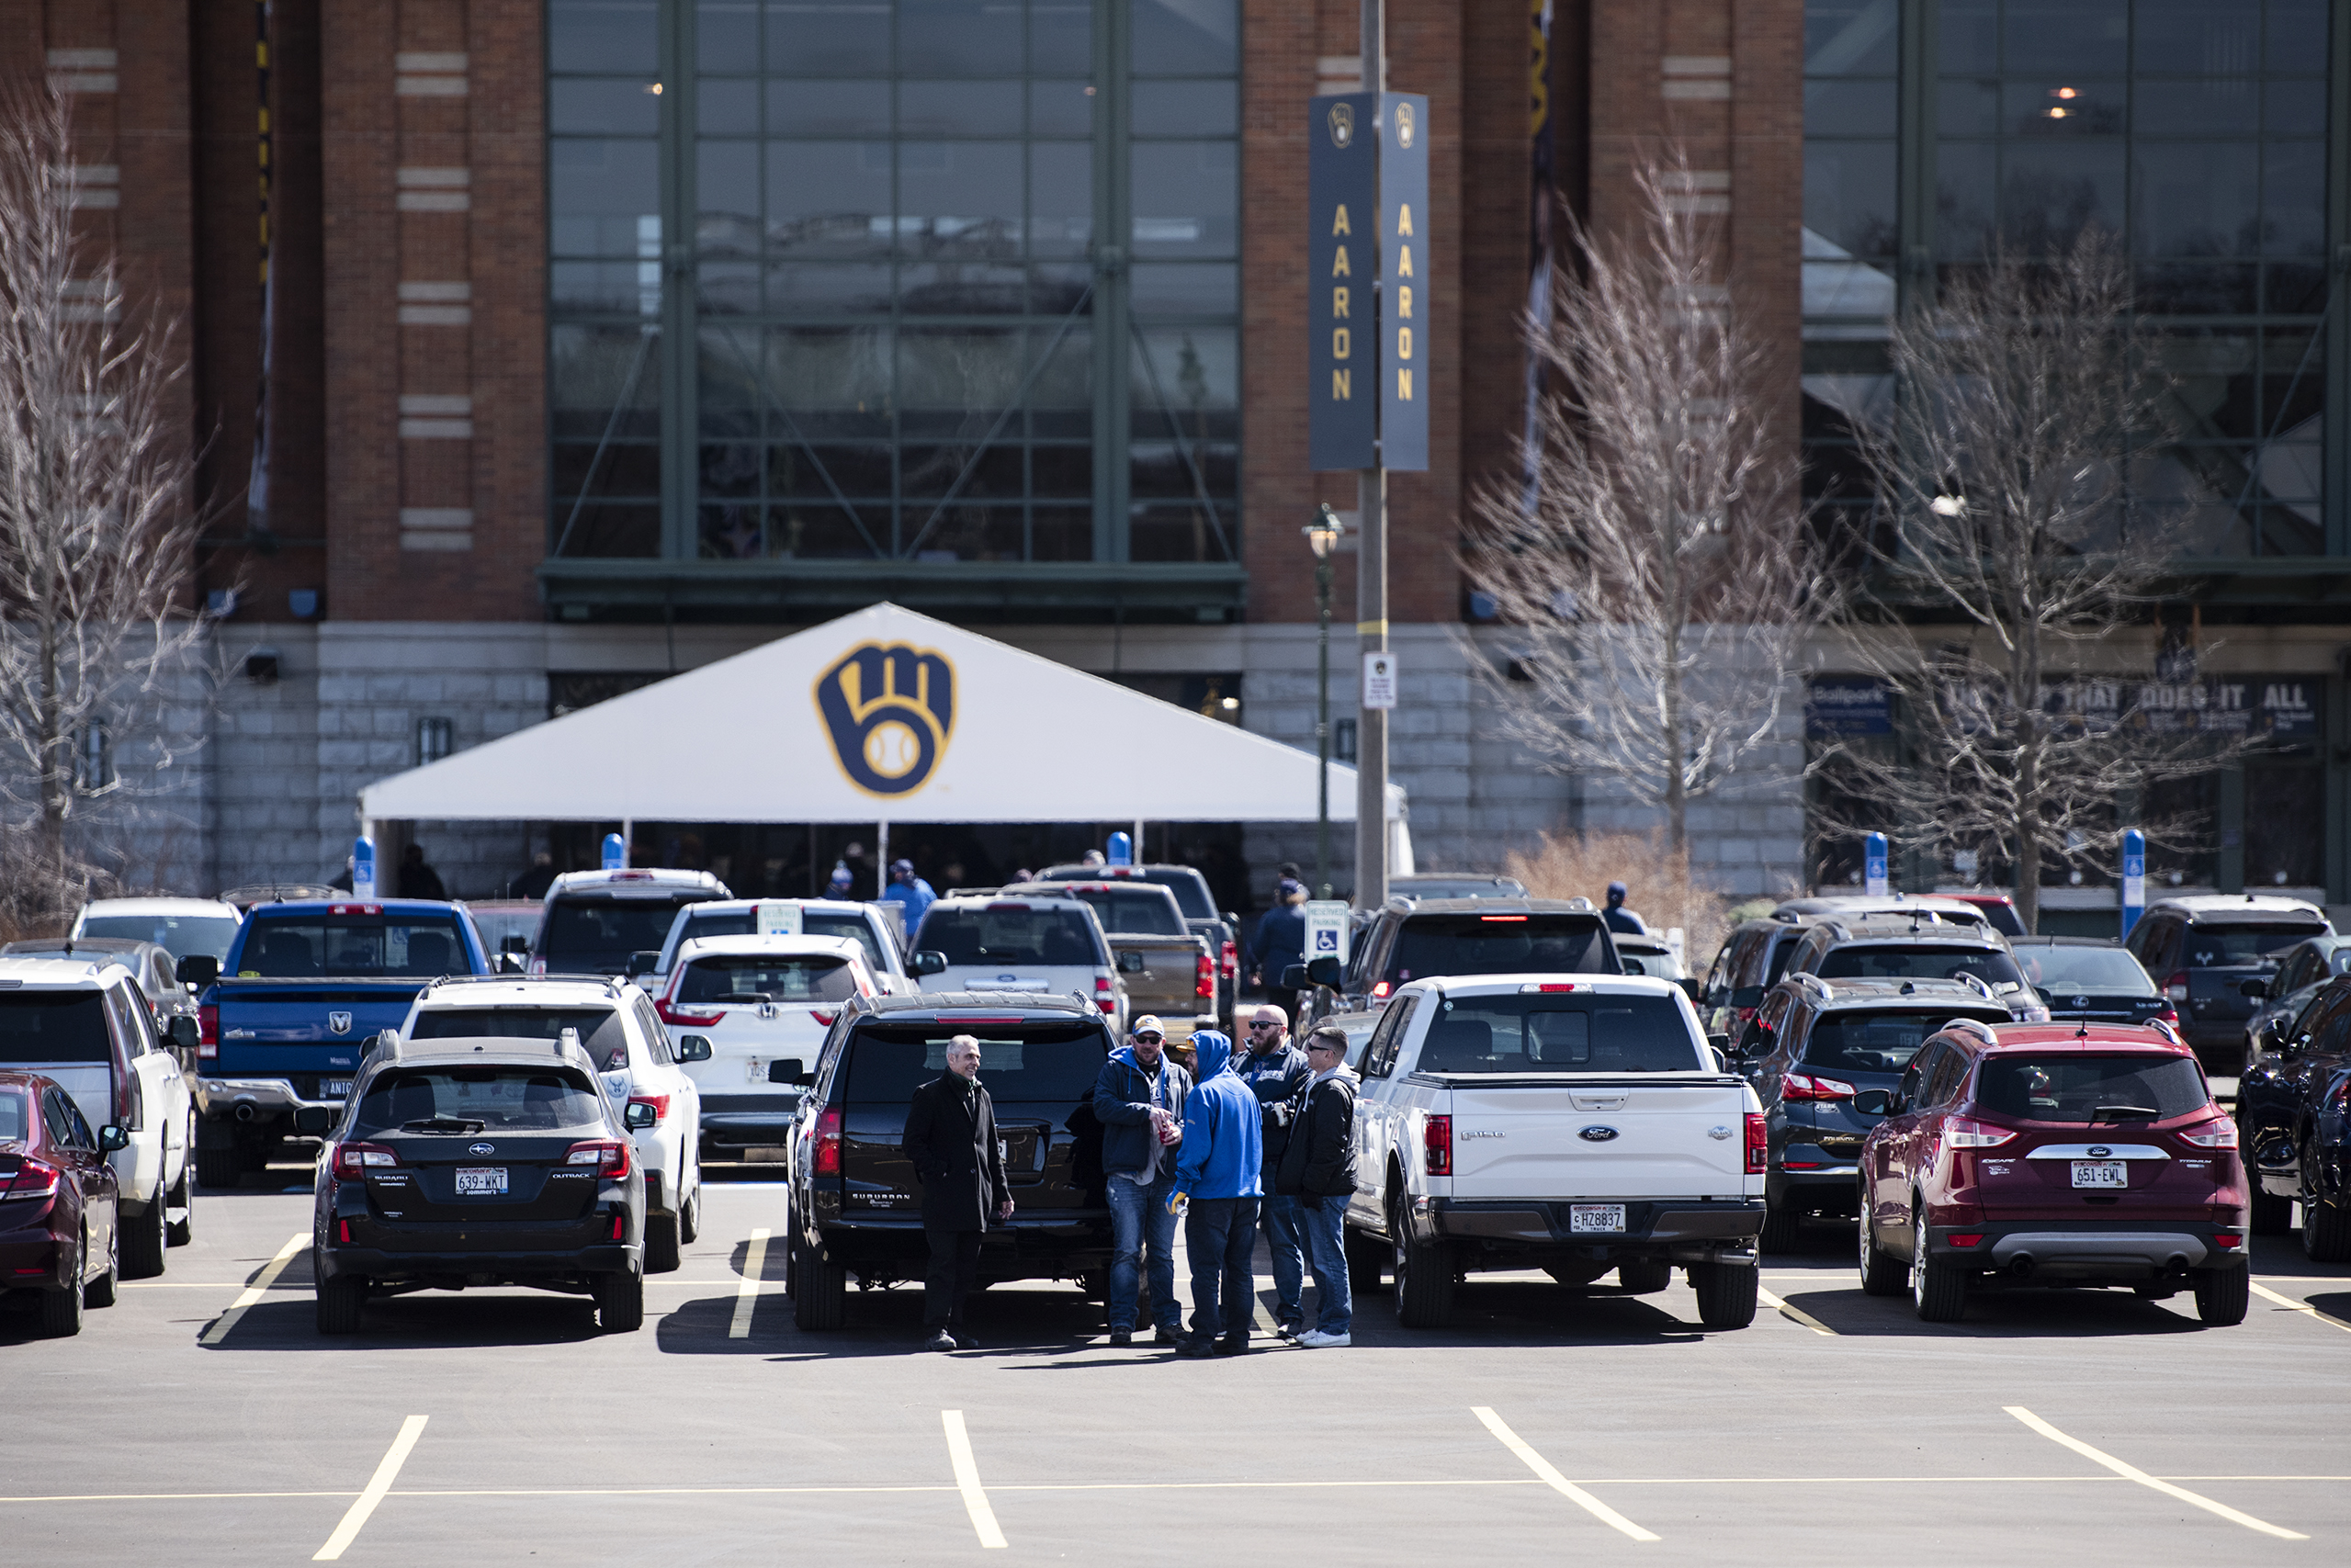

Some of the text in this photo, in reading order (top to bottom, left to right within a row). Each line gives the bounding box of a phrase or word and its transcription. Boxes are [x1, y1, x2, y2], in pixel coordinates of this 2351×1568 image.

[1332, 204, 1351, 400] AARON
[1397, 203, 1413, 400] AARON
[2220, 683, 2245, 709] IT
[2264, 683, 2307, 709] ALL
[1310, 908, 1344, 916] RESERVED
[1587, 1128, 1611, 1139] Ford
[2076, 1168, 2122, 1182] 651-EWL
[458, 1175, 504, 1190] 639-WKT
[1581, 1213, 1621, 1226] HZ8837
